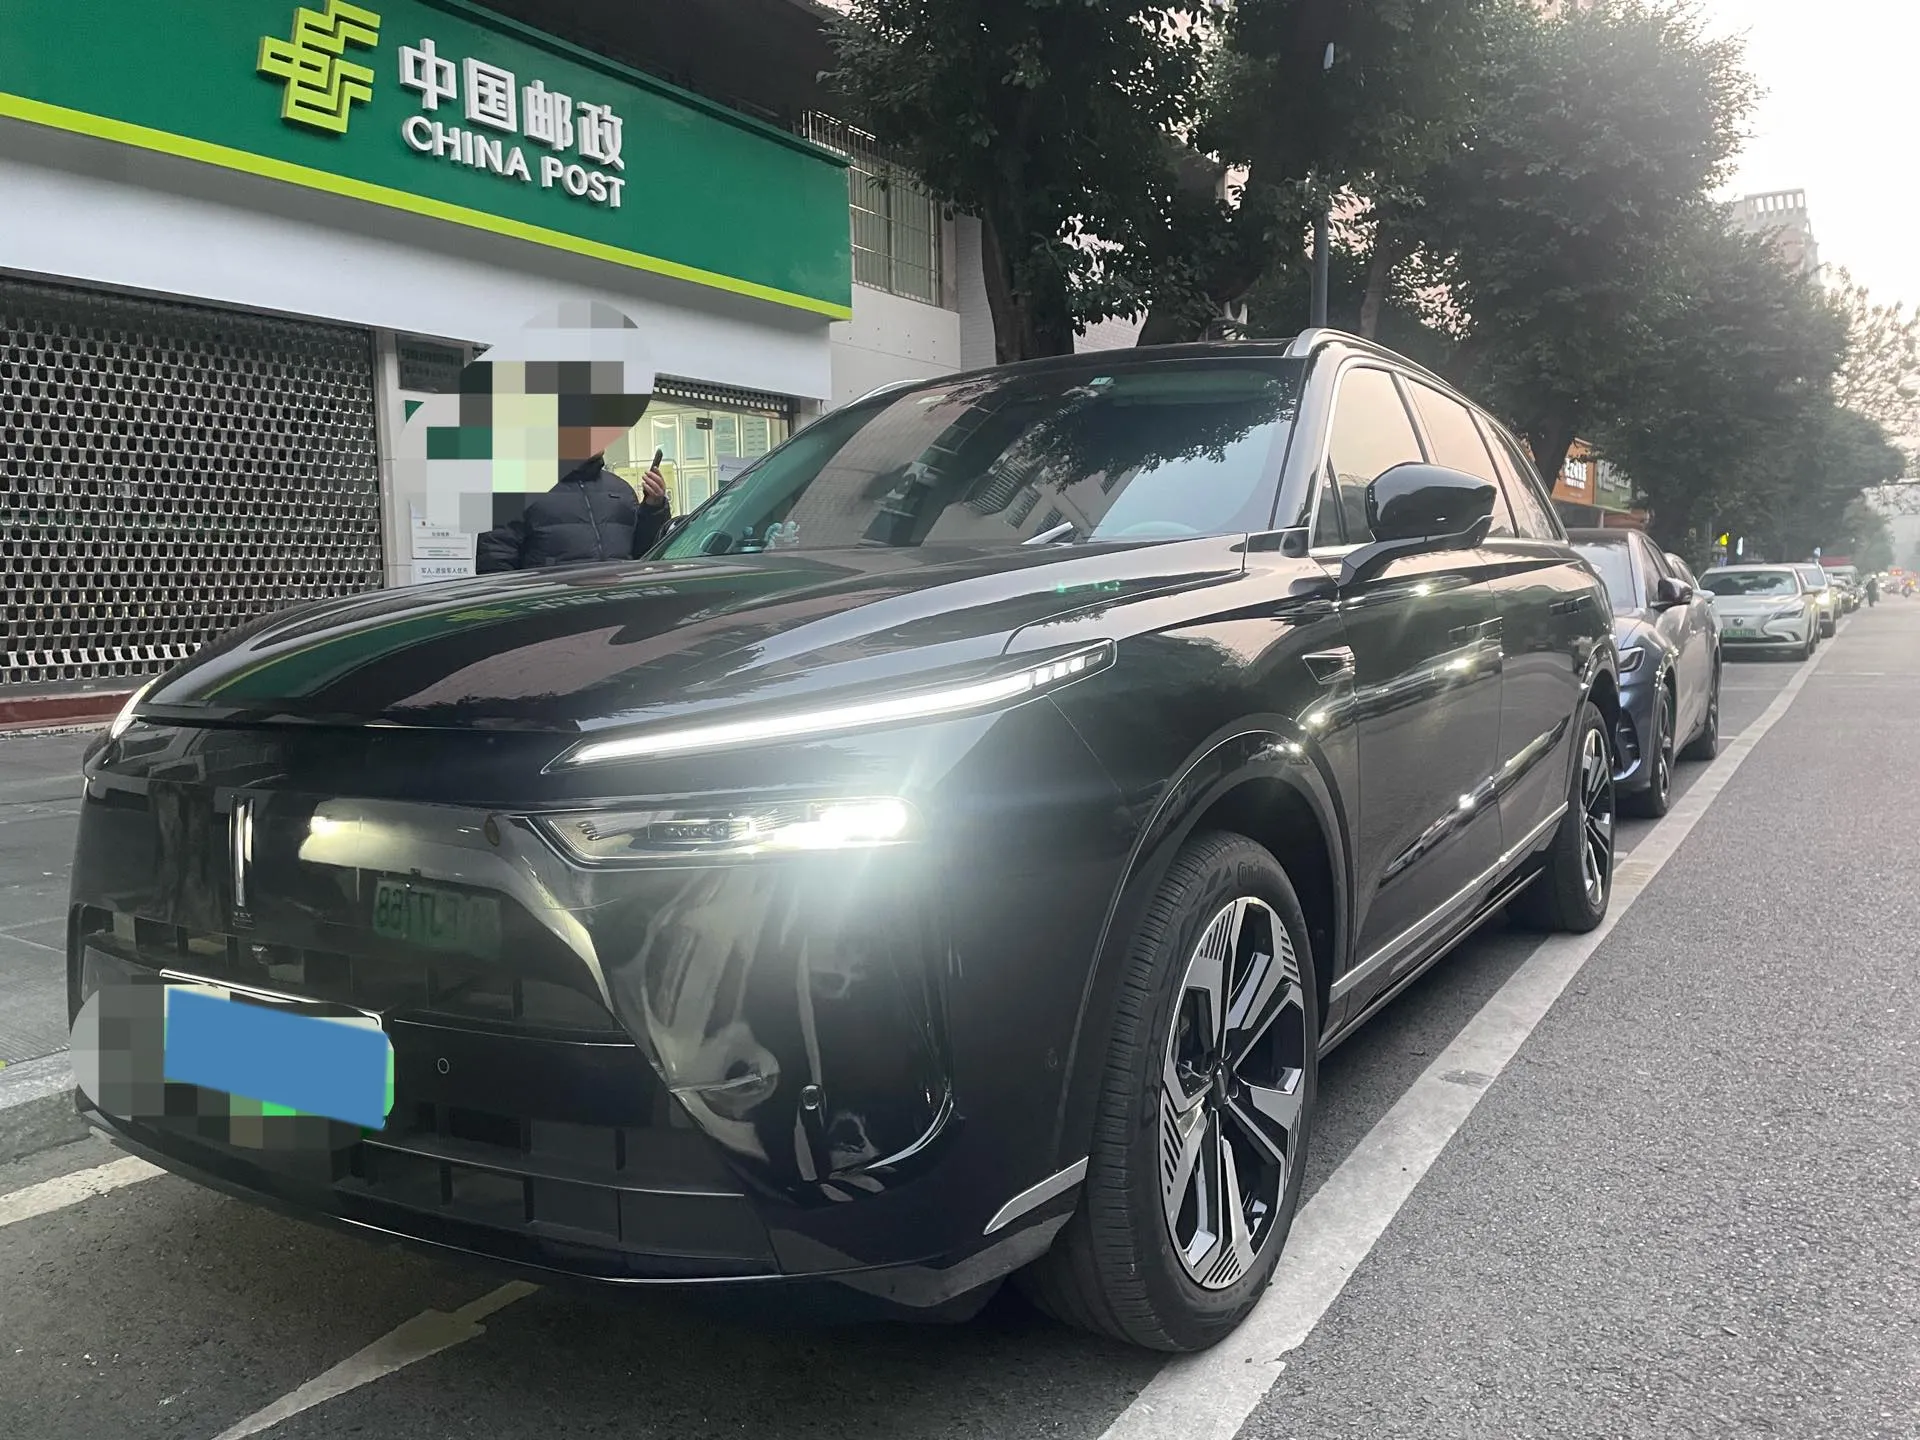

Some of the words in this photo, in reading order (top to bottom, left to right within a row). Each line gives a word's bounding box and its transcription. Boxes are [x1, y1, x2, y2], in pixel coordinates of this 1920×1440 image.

[399, 38, 625, 171] 中国邮政
[402, 115, 532, 182] CHINA
[540, 155, 625, 208] POST
